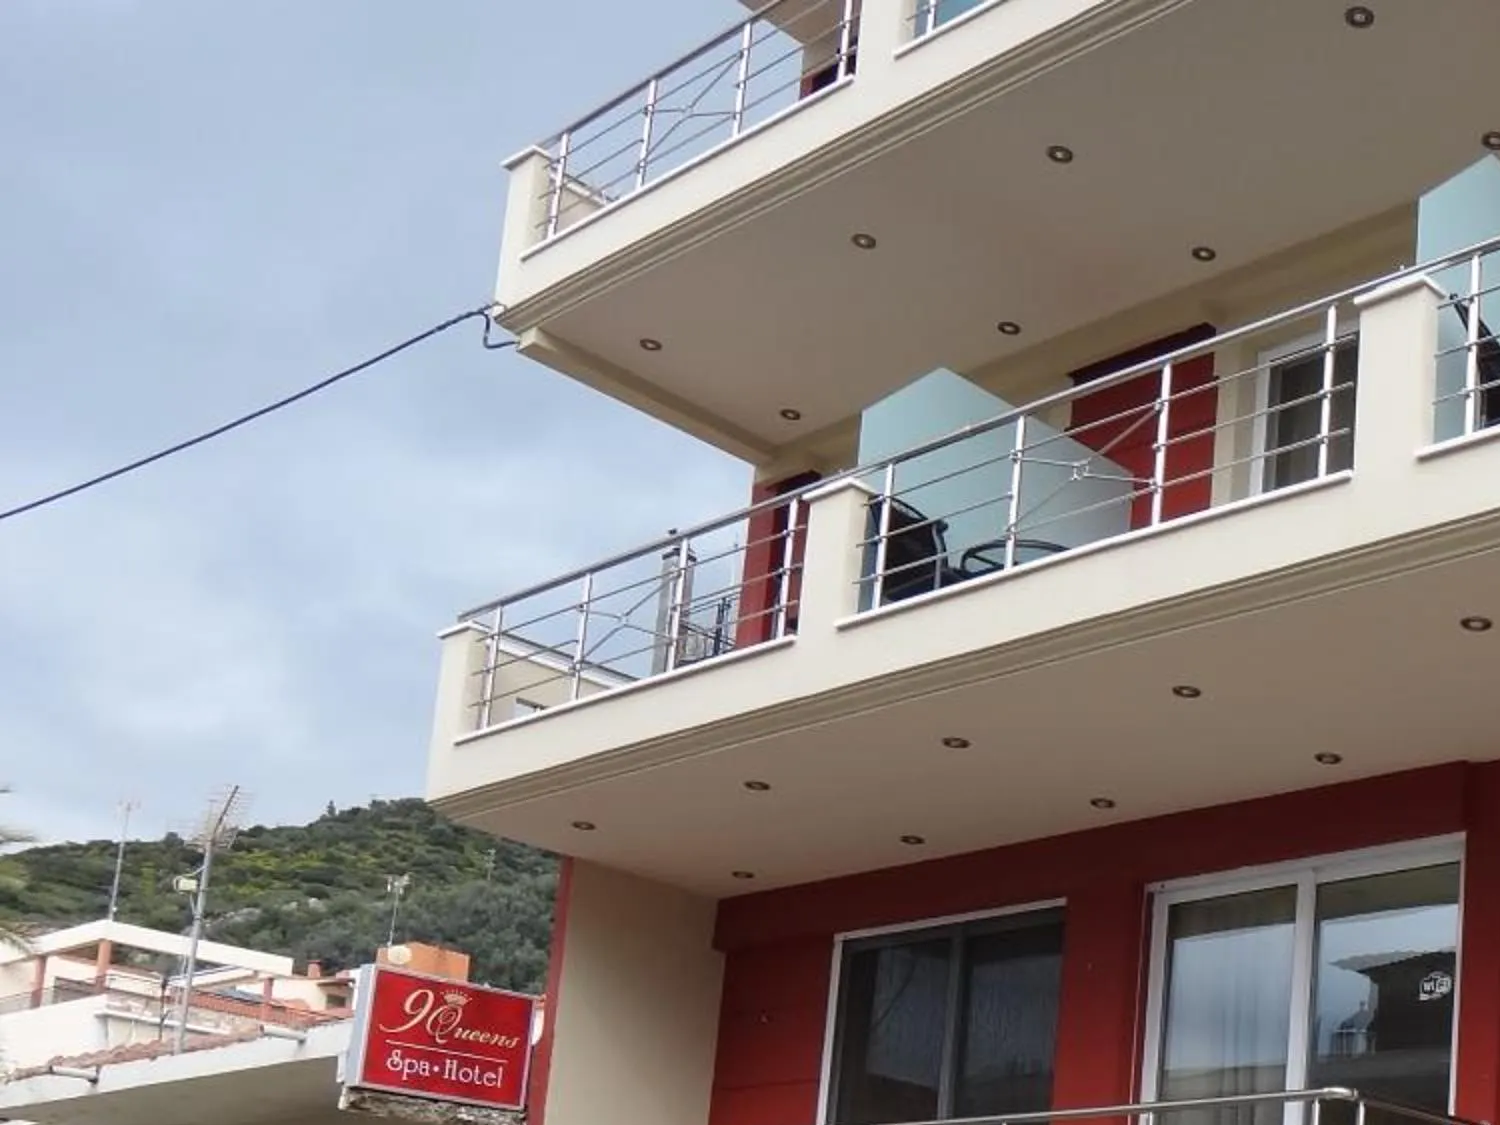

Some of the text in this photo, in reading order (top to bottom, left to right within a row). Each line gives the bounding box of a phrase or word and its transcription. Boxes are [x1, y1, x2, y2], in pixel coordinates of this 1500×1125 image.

[378, 988, 435, 1034] 9
[386, 1049, 504, 1089] Spa Hotel
